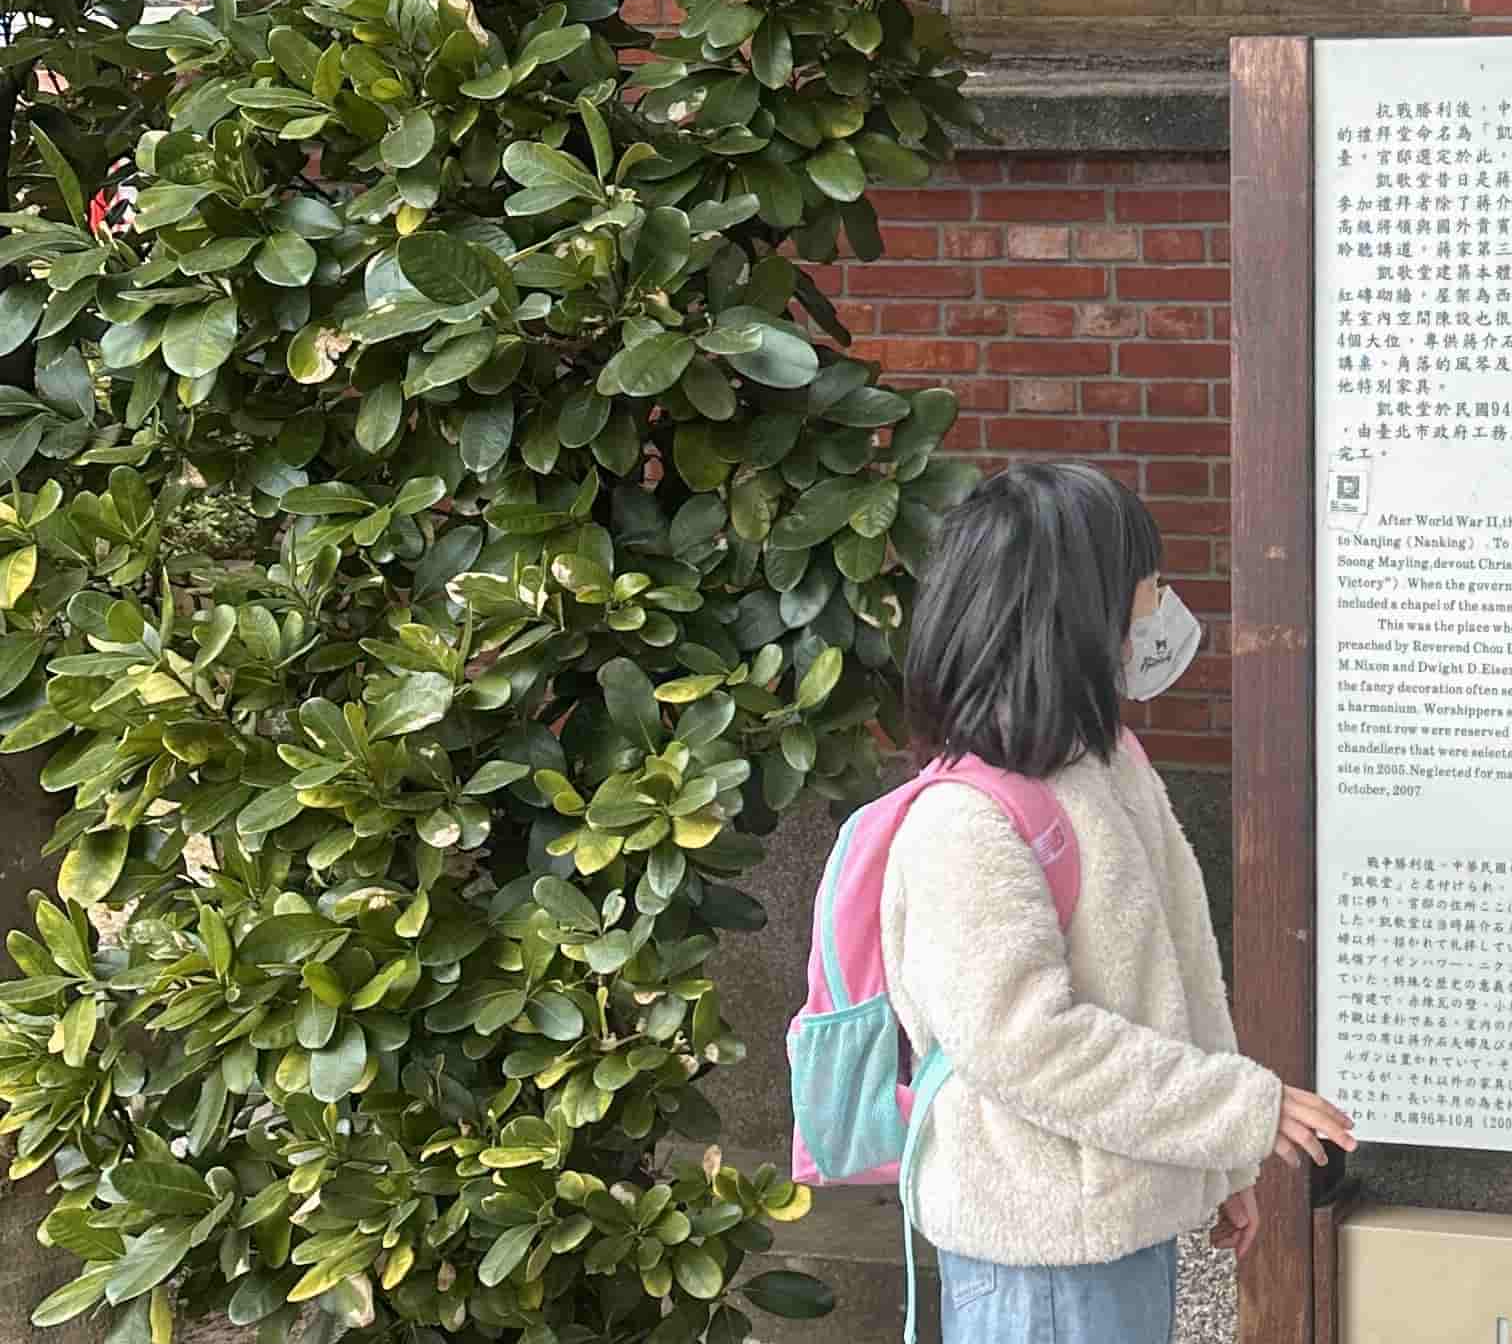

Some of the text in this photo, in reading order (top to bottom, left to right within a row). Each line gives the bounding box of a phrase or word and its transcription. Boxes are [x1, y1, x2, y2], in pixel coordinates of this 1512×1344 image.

[1377, 513, 1413, 527] After
[1415, 514, 1454, 527] World
[1352, 533, 1402, 550] Nanjing
[1407, 577, 1443, 591] When
[1445, 578, 1466, 591] the
[1337, 596, 1389, 610] included
[1400, 597, 1441, 614] chapel
[1458, 599, 1479, 612] the
[1377, 617, 1404, 631] This
[1406, 622, 1432, 632] was
[1433, 619, 1455, 633] the
[1457, 620, 1490, 636] place
[1337, 639, 1393, 653] preached
[1412, 639, 1470, 654] Reverend
[1472, 641, 1504, 655] Chou
[1392, 659, 1415, 673] and
[1417, 660, 1464, 676] Dwight
[1337, 679, 1358, 692] the
[1359, 679, 1395, 696] fancy
[1397, 680, 1463, 695] decoration
[1465, 683, 1499, 697] often
[1423, 702, 1504, 720] Worshippers
[1337, 720, 1358, 733] the
[1360, 721, 1393, 735] front
[1393, 725, 1419, 735] row
[1420, 726, 1452, 737] were
[1454, 726, 1510, 739] reserved
[1337, 741, 1407, 756] chandeliers
[1409, 743, 1436, 757] that
[1437, 746, 1469, 758] were
[1337, 761, 1361, 775] site
[1473, 766, 1494, 780] for
[1391, 783, 1422, 797] 2007
